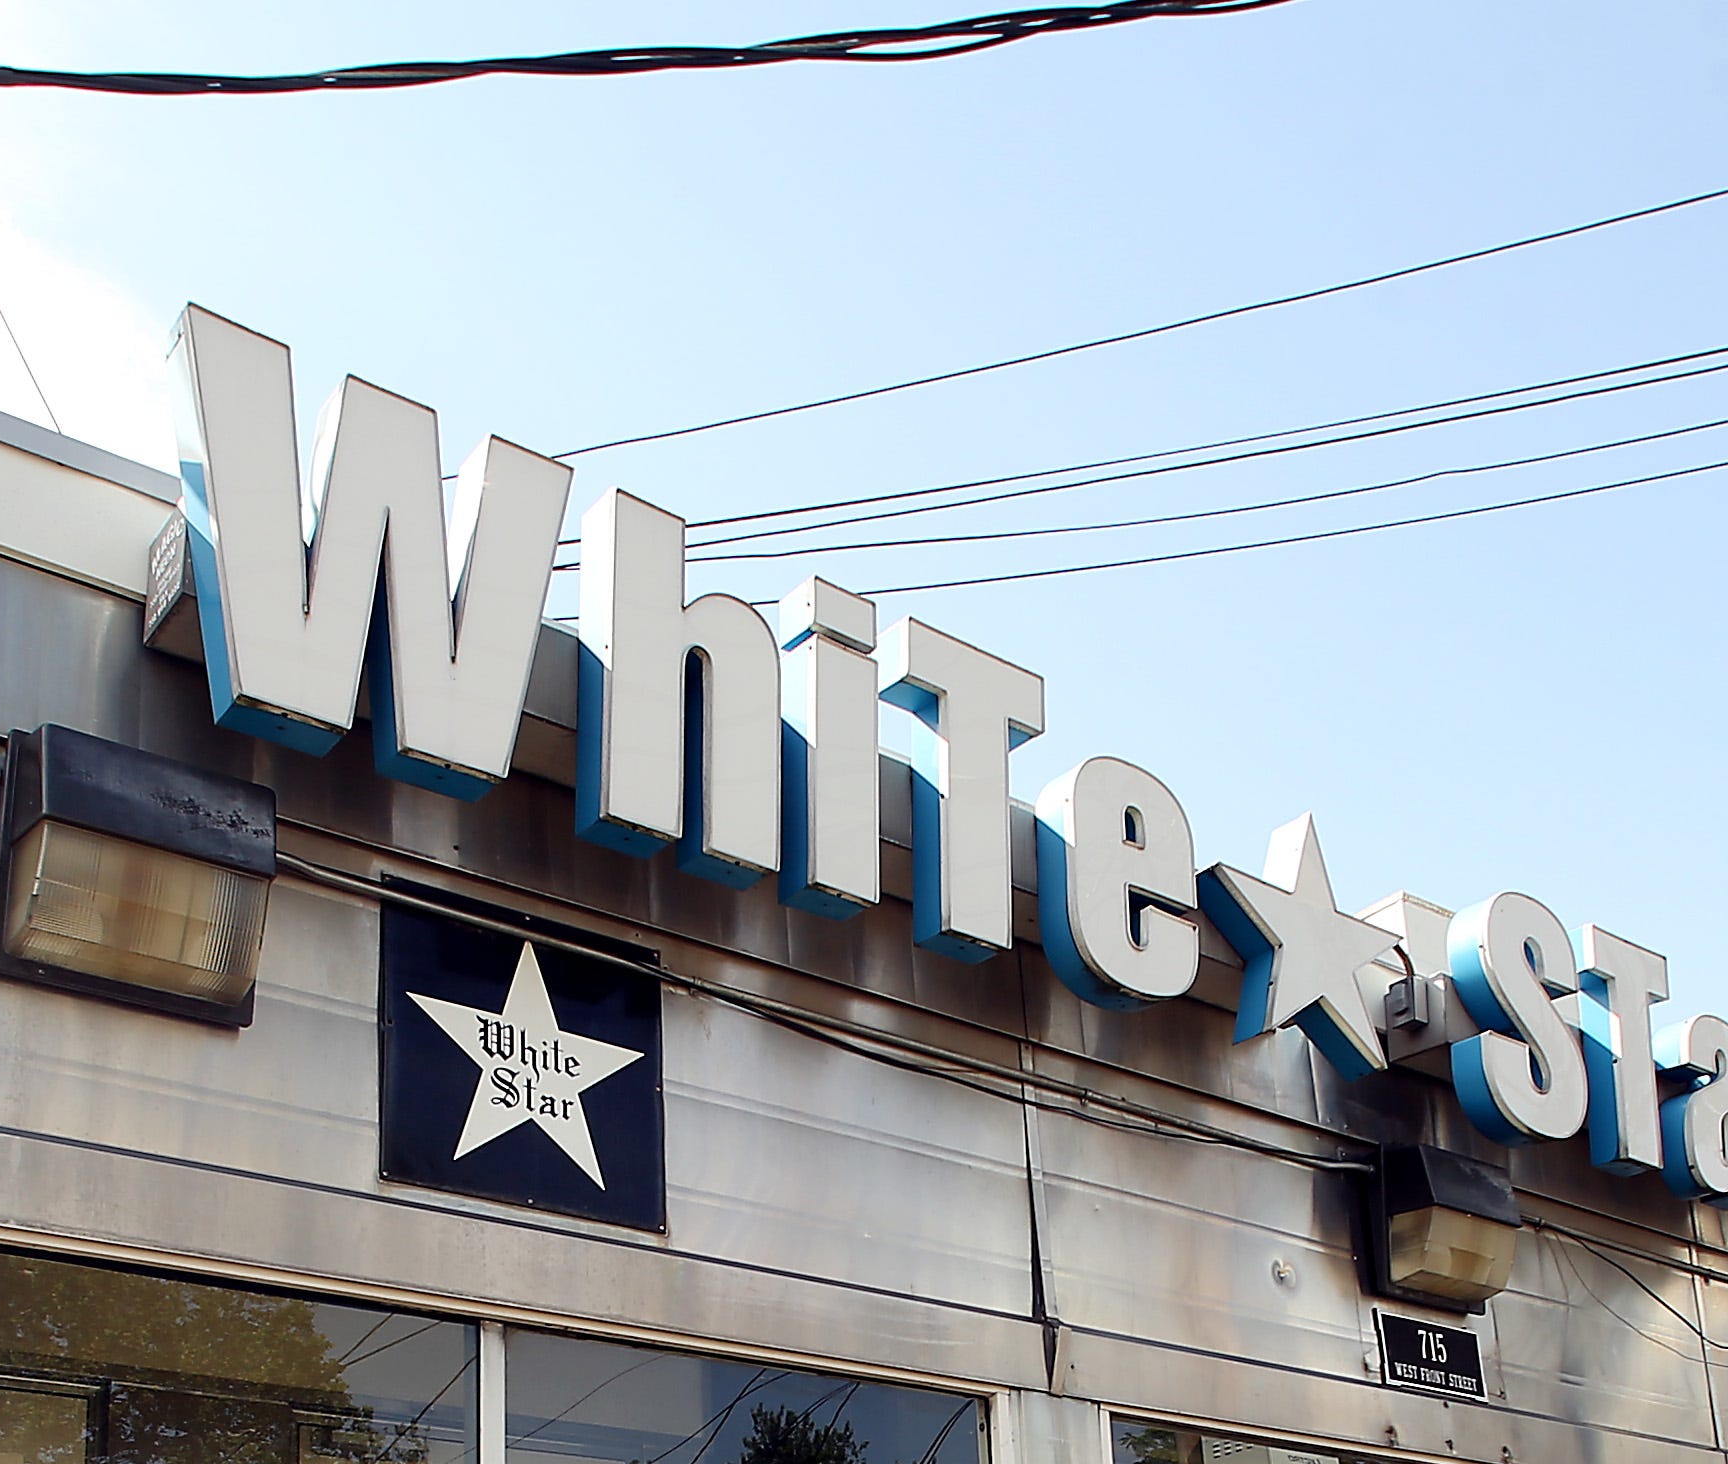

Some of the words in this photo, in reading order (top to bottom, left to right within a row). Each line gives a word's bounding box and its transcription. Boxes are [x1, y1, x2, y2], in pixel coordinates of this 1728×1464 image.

[475, 1015, 581, 1083] White
[490, 1067, 575, 1120] Star
[1417, 1329, 1447, 1363] 715
[1394, 1362, 1418, 1380] WEST
[1420, 1367, 1446, 1386] FRONT
[1449, 1373, 1478, 1392] STREET
